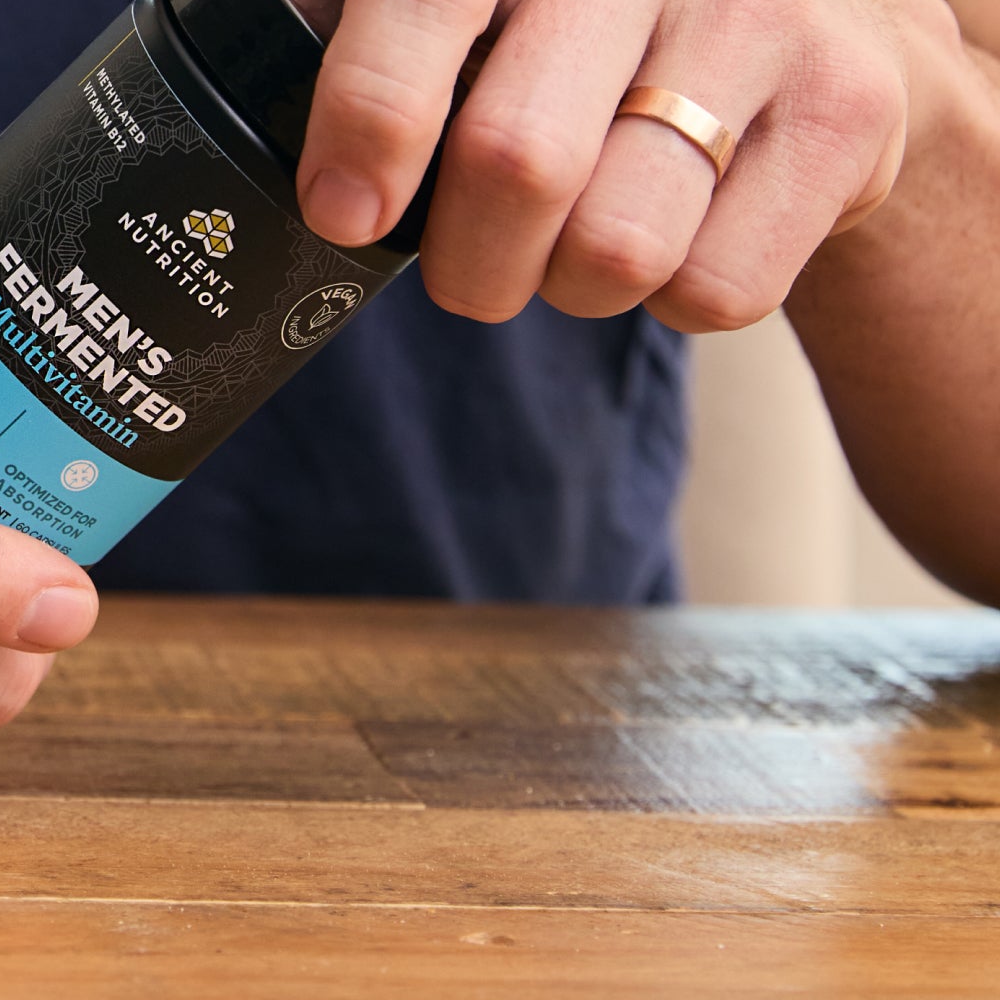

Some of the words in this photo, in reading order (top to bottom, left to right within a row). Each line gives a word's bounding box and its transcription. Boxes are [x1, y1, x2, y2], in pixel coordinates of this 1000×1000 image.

[83, 81, 112, 129] VITAMIN
[107, 126, 127, 152] B12
[96, 67, 145, 144] METHYLATED
[118, 211, 229, 319] NUTRITION
[141, 212, 234, 295] ANCIENT
[56, 265, 172, 376] MEN'S
[4, 464, 73, 516] OPTIMIZED
[70, 511, 97, 528] FOR
[15, 522, 31, 534] 60
